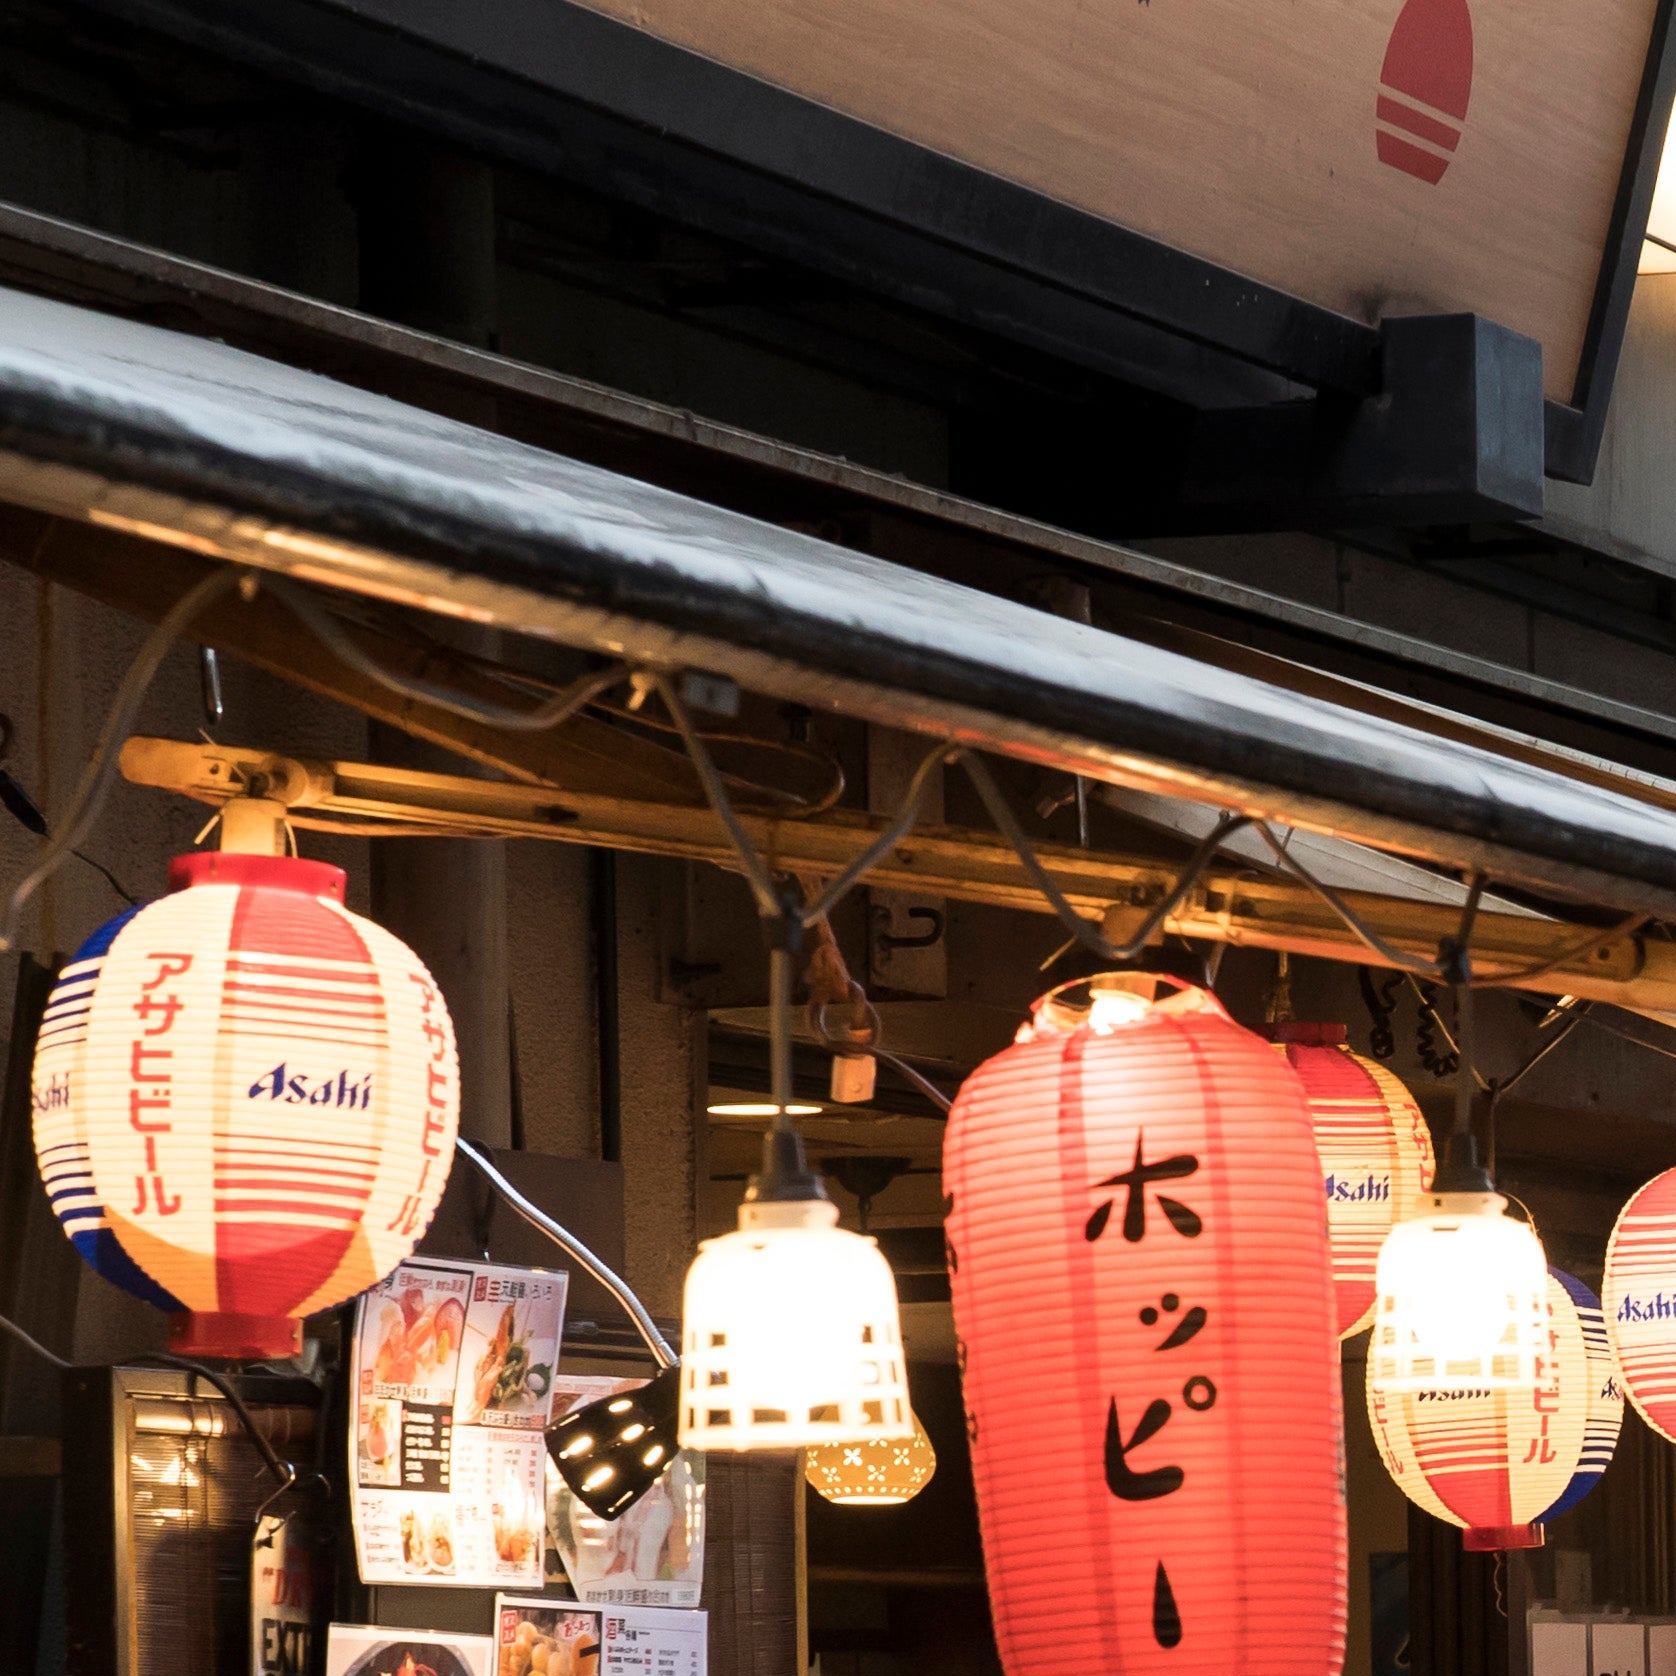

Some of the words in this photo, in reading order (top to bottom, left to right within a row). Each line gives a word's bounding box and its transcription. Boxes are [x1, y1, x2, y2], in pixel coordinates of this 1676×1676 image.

[130, 953, 195, 1219] アサヒビール
[249, 1062, 375, 1112] Asahi
[386, 972, 451, 1240] アサヒビール
[1083, 1126, 1220, 1652] ホッピー
